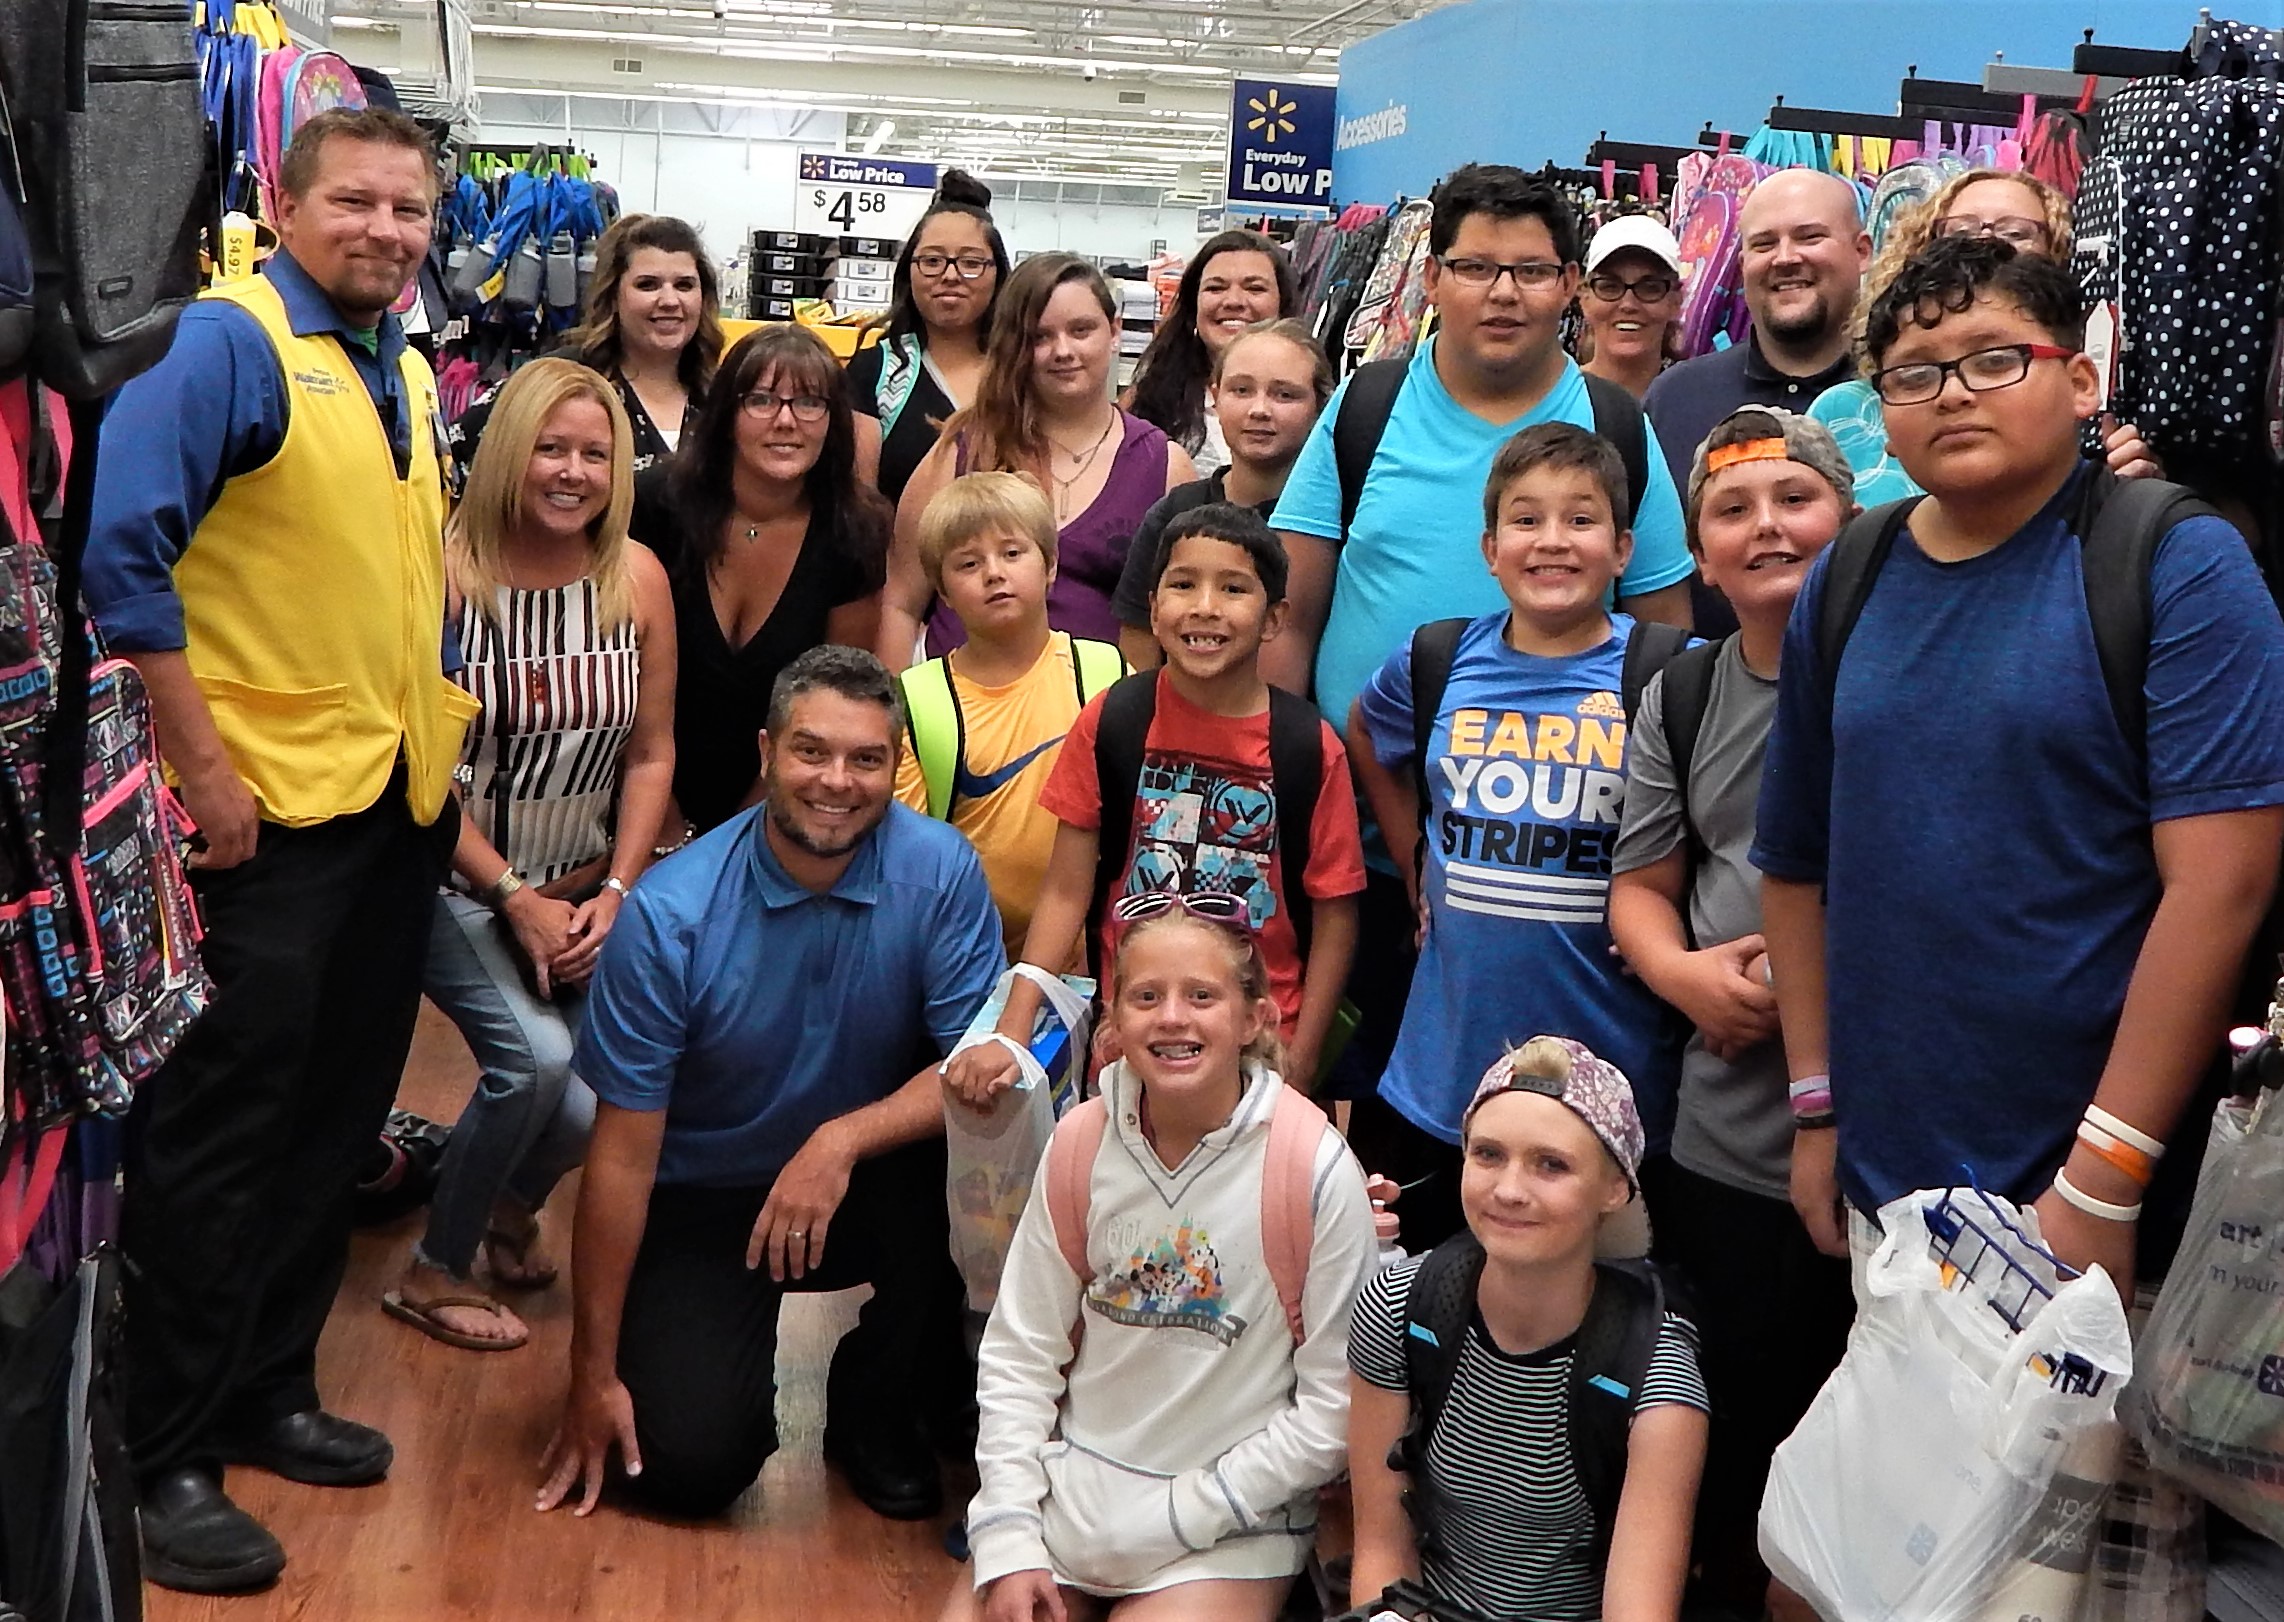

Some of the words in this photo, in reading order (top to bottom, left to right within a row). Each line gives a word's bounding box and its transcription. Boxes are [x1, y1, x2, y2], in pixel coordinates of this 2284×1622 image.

[1336, 99, 1407, 151] Accessories
[829, 164, 863, 181] Low
[864, 167, 906, 184] Price
[1245, 148, 1307, 168] Everyday
[1243, 163, 1310, 195] Low
[228, 236, 243, 275] $4.97
[1576, 702, 1627, 720] adidas
[1450, 709, 1628, 770] EARN
[1439, 757, 1627, 824] YOUR
[1441, 810, 1619, 874] STRIPES
